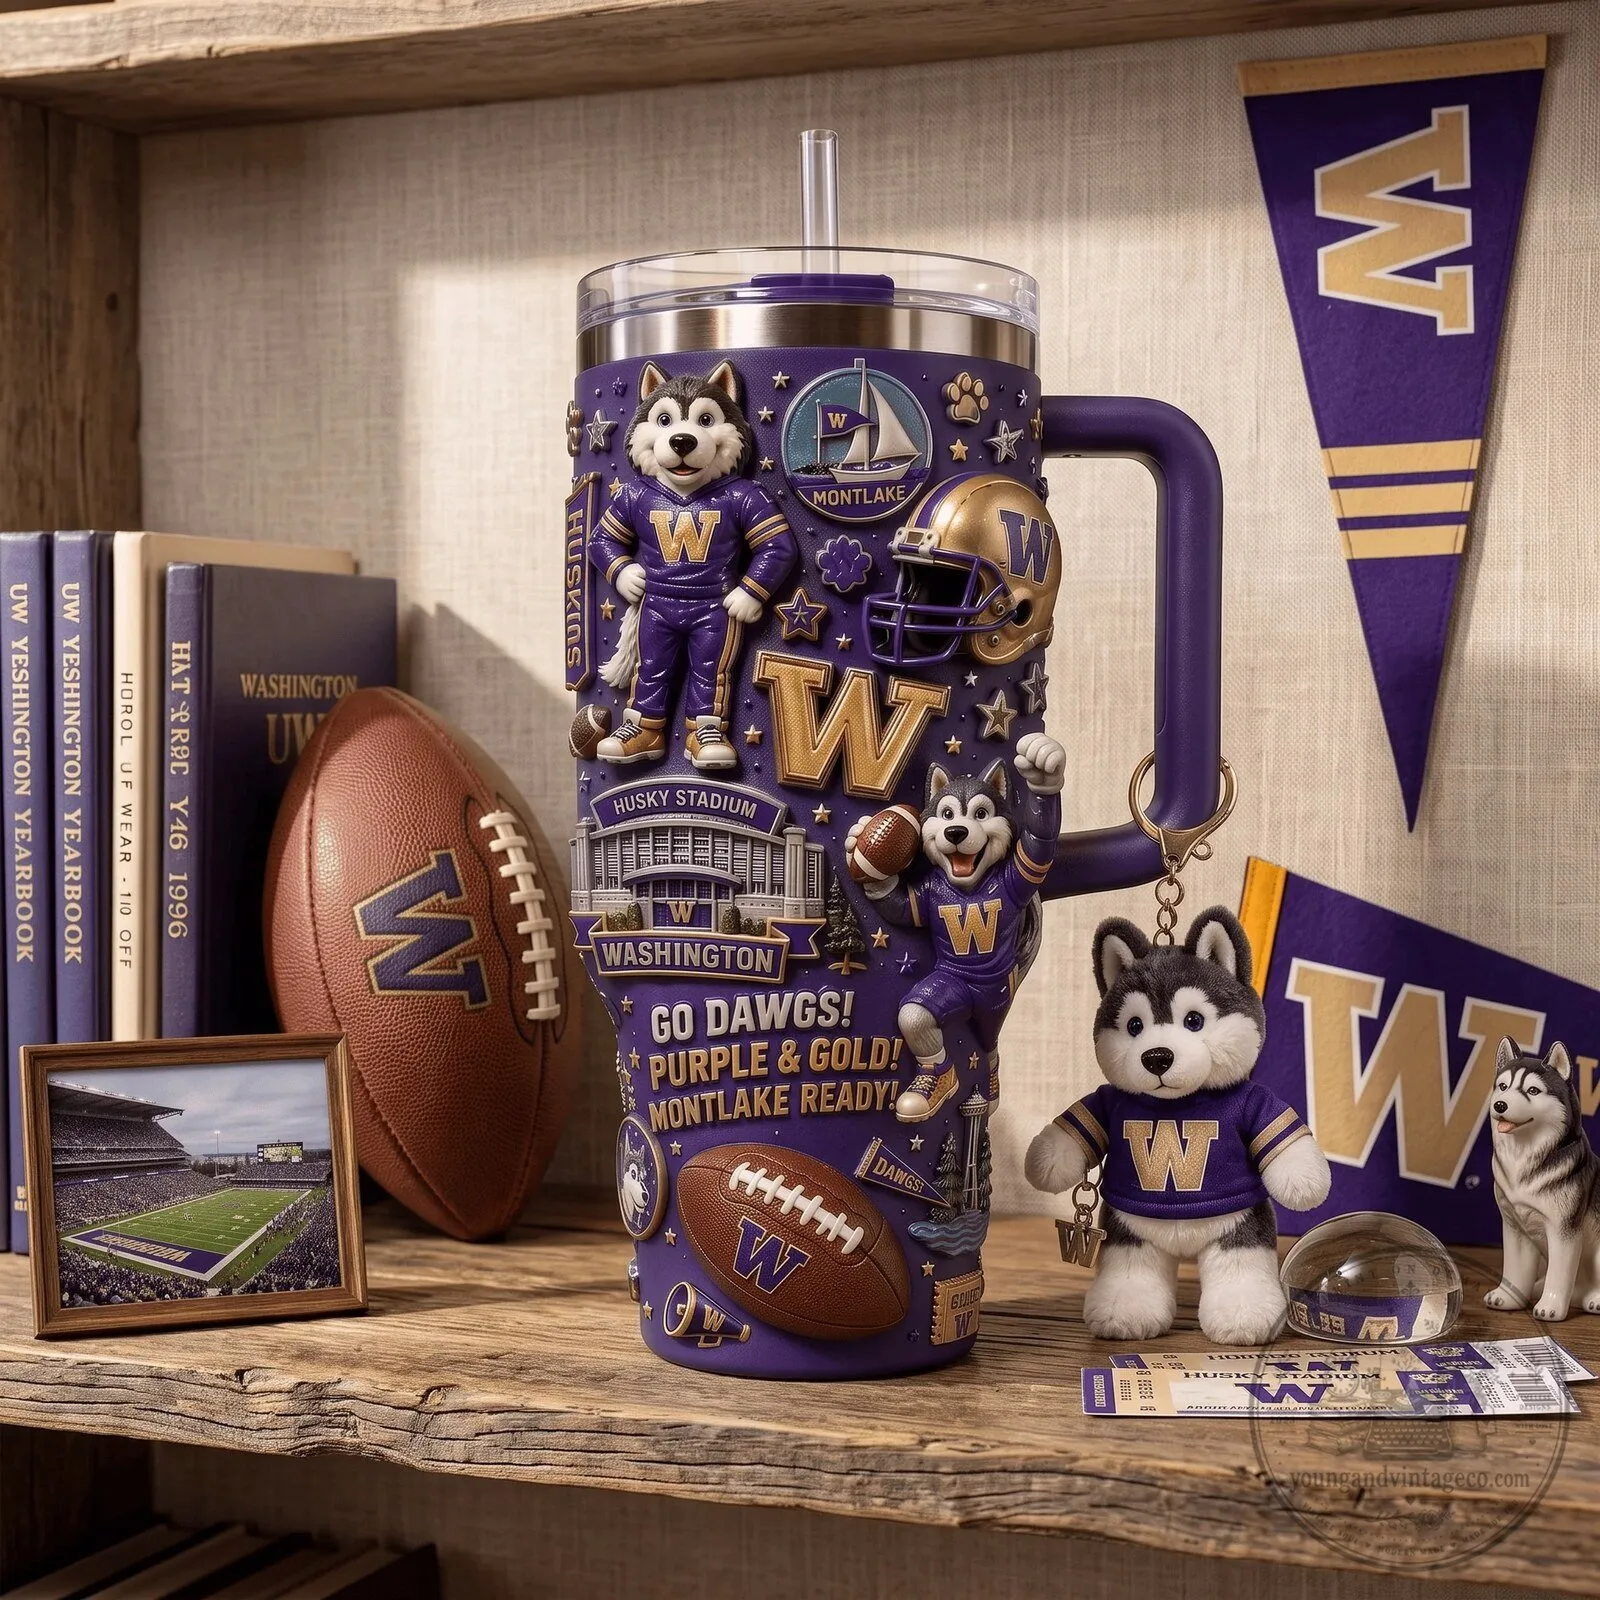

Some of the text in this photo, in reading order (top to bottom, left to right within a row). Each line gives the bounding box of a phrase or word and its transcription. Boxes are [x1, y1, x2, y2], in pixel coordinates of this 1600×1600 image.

[1314, 104, 1475, 336] W
[828, 412, 848, 430] W
[813, 484, 906, 508] MONTLAKE
[649, 510, 721, 563] W
[999, 507, 1054, 585] W
[120, 672, 134, 747] HOROL
[240, 673, 358, 699] WASHINGTON
[753, 650, 952, 800] W
[9, 583, 34, 962] UW YESHINGTON YEARBOOK
[60, 582, 83, 964] UW YESHINGTON YEARBOOK
[613, 789, 758, 819] HUSKY STADIUM
[119, 803, 133, 864] WEAR
[168, 872, 188, 938] 1996
[353, 849, 492, 1011] W
[666, 901, 696, 923] W
[938, 898, 1002, 956] W
[119, 929, 132, 969] OFF
[601, 941, 774, 974] WASHINGTON
[651, 991, 855, 1045] GO DAWGS!
[648, 1037, 904, 1091] PURPLE & GOLD!
[1285, 957, 1547, 1189] W
[648, 1081, 899, 1133] MONTLAKE READY!
[1123, 1119, 1220, 1192] W
[732, 1217, 811, 1294] W
[1055, 1219, 1107, 1268] W
[703, 1303, 727, 1332] W
[1184, 1372, 1382, 1380] HUSKY STADIUM
[1234, 1383, 1334, 1404] W
